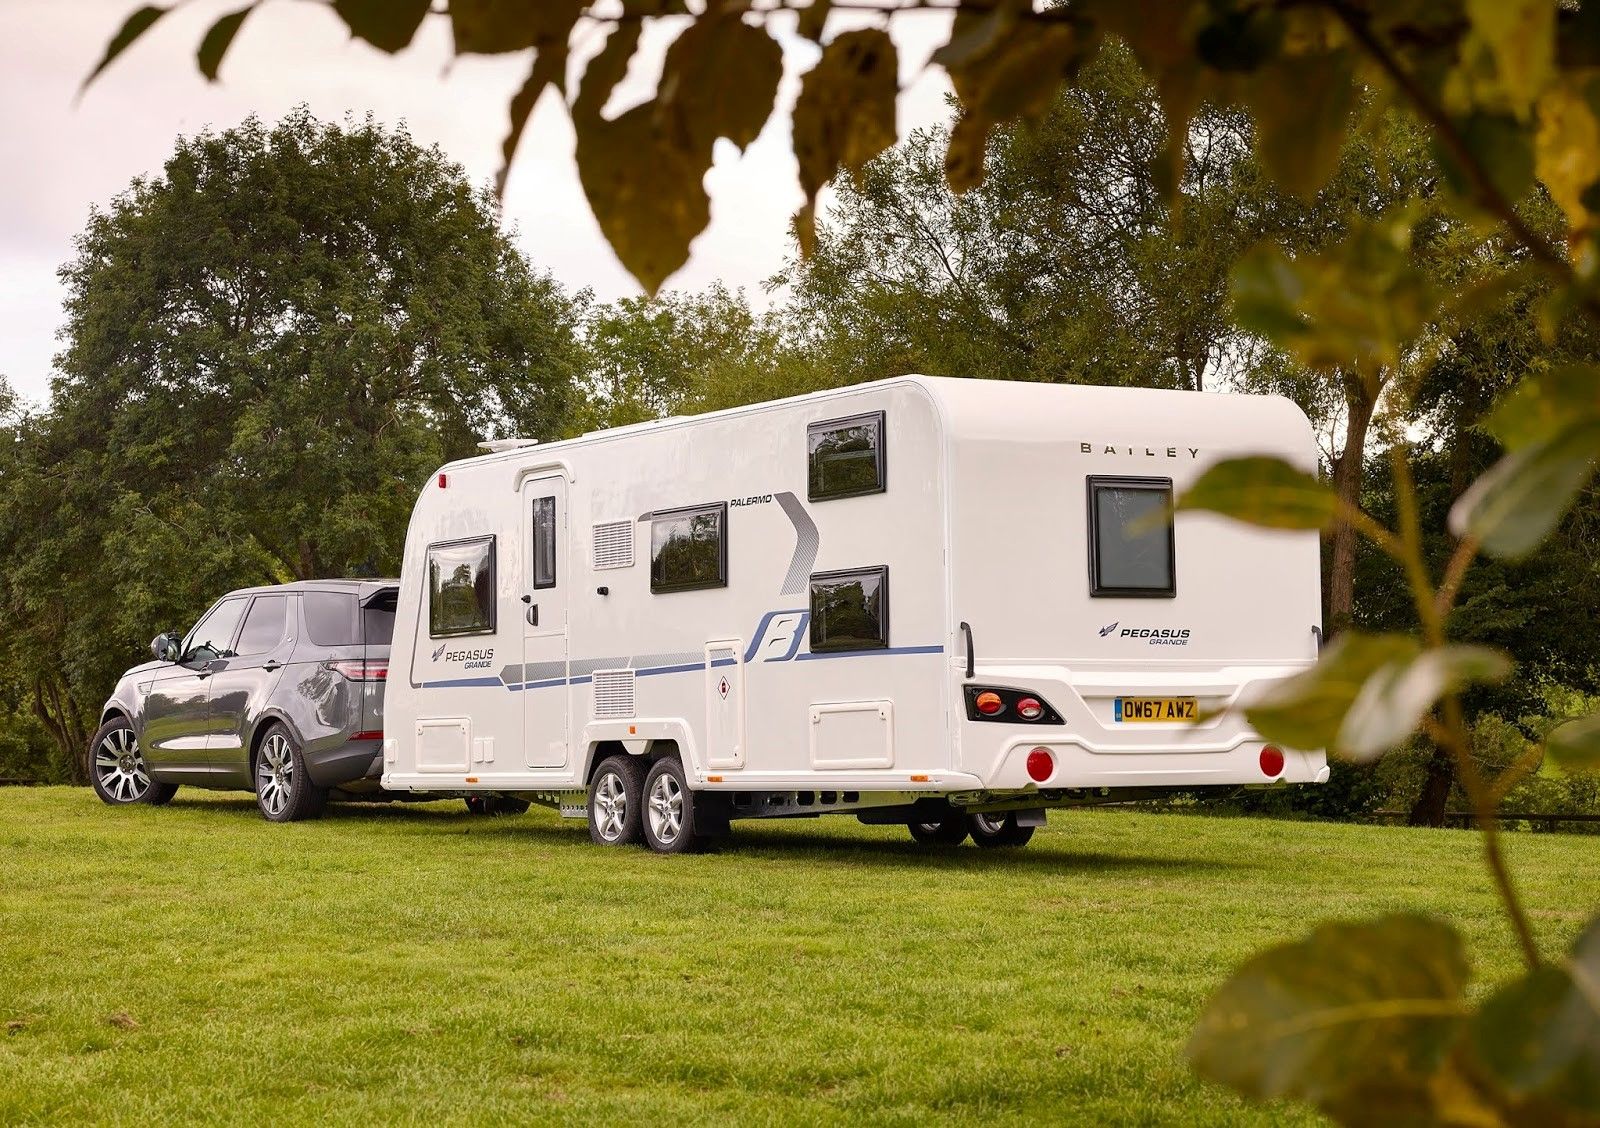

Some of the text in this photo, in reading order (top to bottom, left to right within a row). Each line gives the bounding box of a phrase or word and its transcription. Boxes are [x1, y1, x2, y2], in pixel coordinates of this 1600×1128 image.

[1080, 442, 1198, 459] BAILEY
[730, 494, 773, 507] PALERMO
[1120, 628, 1191, 638] PEGASUS
[1149, 638, 1188, 646] GRANDE
[445, 648, 494, 662] PEGASUS
[464, 660, 492, 670] GRANDE
[1124, 701, 1194, 718] OW67 AWZ
